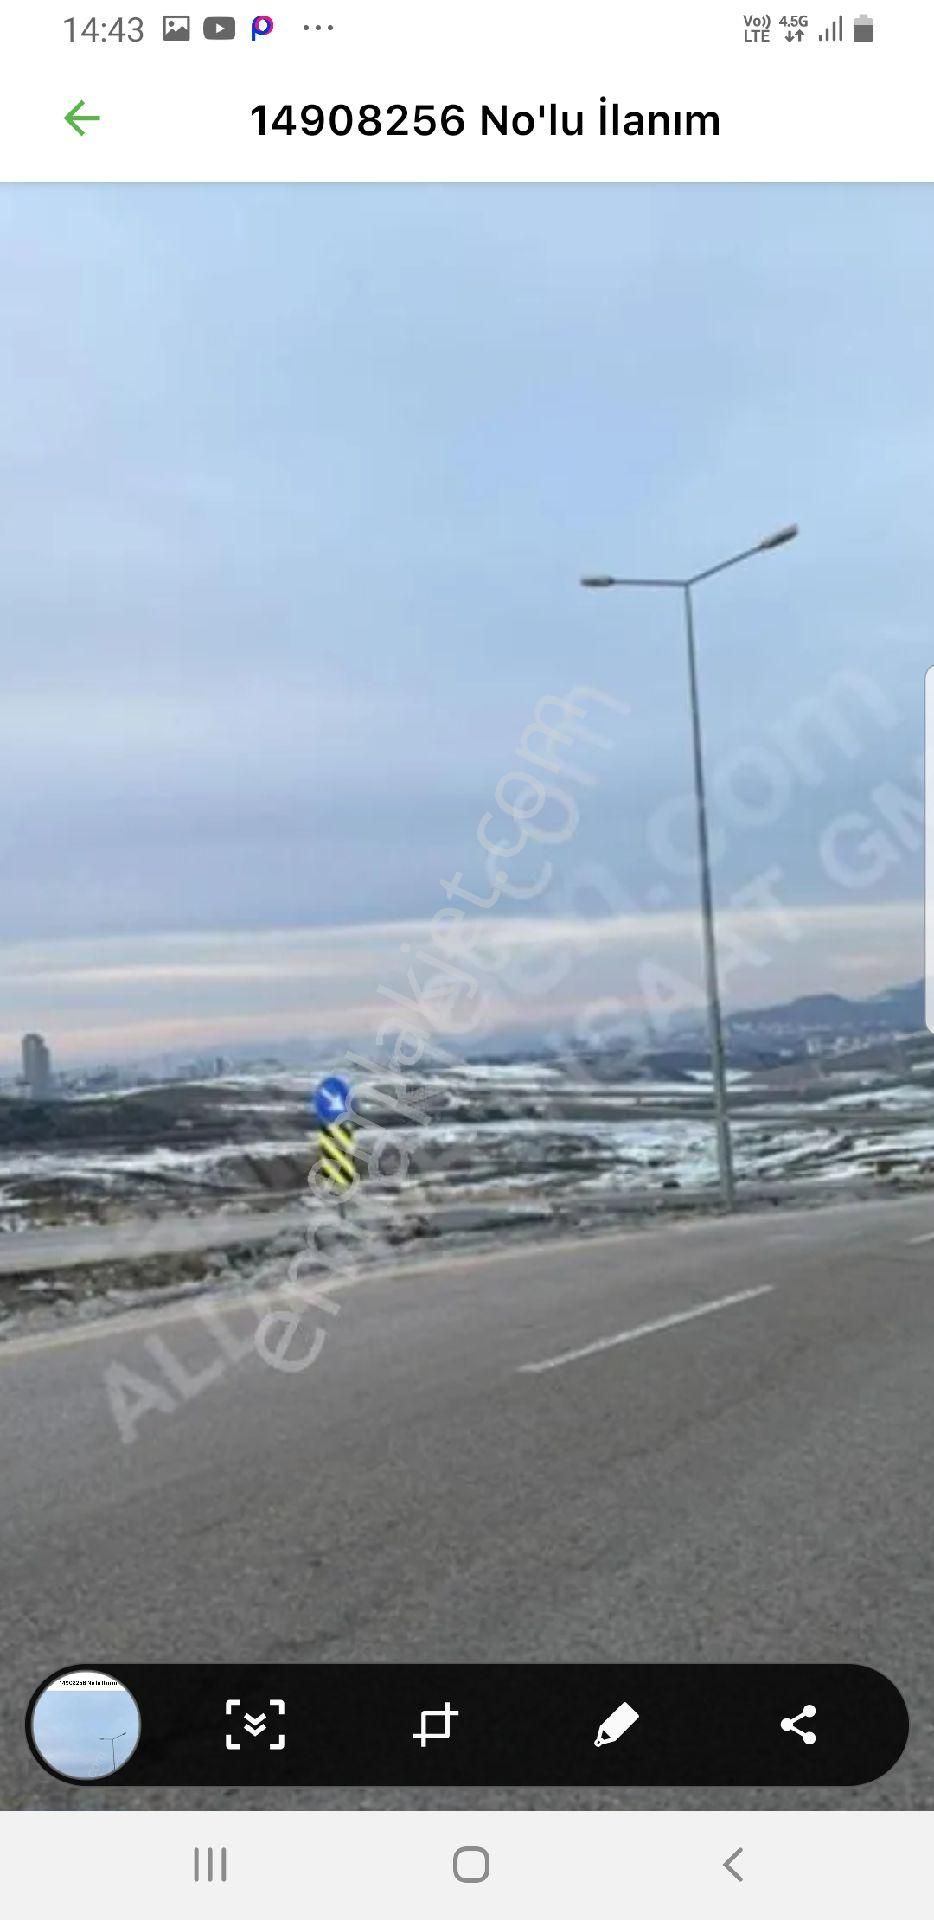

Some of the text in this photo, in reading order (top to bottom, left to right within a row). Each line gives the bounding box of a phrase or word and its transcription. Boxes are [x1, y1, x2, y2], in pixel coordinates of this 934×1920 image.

[63, 16, 144, 43] 14:43
[778, 15, 809, 28] 4.5G
[744, 29, 771, 43] LTE
[251, 95, 720, 137] 14908256 No'lu İlanım
